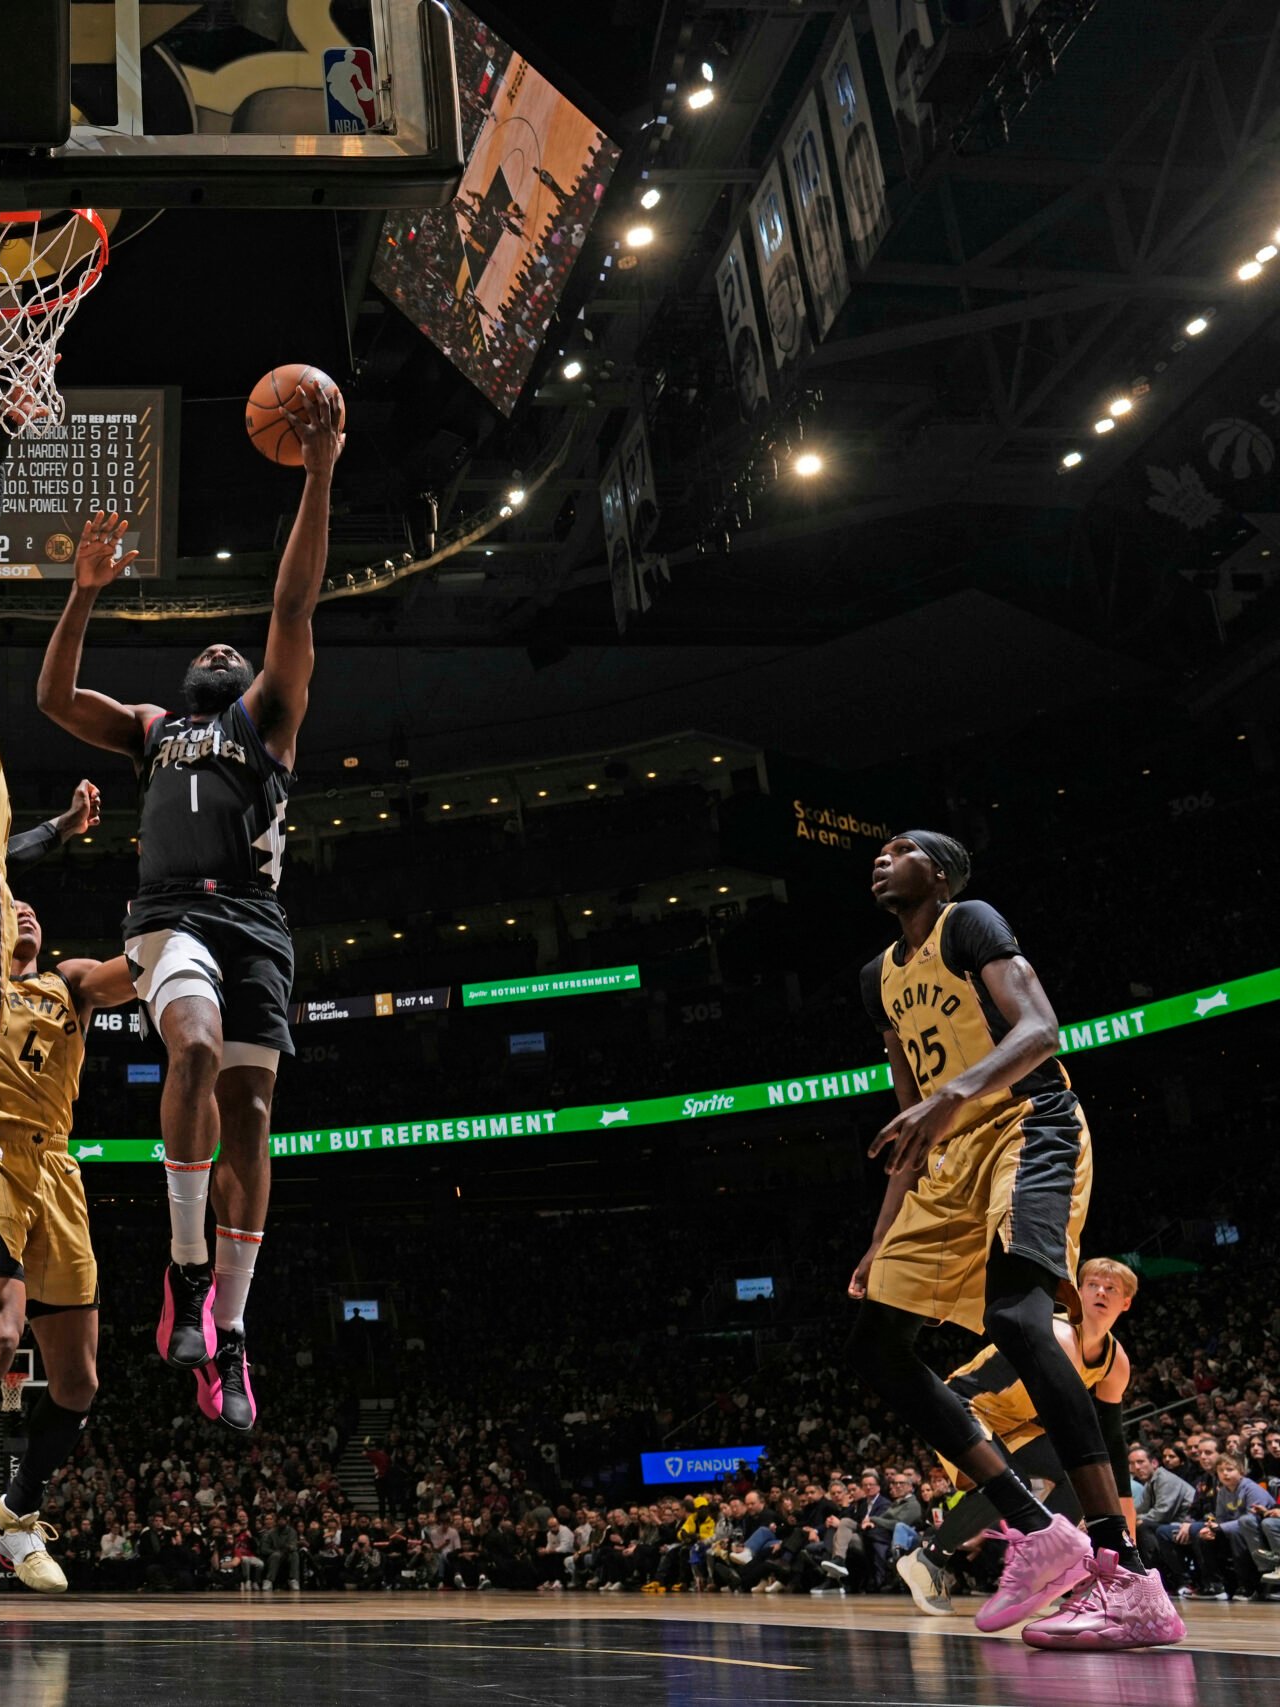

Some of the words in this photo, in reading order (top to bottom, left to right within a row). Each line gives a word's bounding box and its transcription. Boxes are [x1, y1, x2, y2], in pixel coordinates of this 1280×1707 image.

[334, 119, 359, 134] NBA
[723, 255, 747, 333] 21
[71, 415, 87, 424] PTS
[89, 415, 105, 424] REB
[106, 415, 122, 424] AST
[123, 415, 137, 424] FLS
[71, 425, 86, 439] 12
[91, 425, 101, 439] 5
[108, 425, 118, 439] 2
[125, 425, 133, 439] 1
[6, 443, 14, 458] 1
[18, 443, 25, 458] J.
[27, 443, 68, 458] HARDEN
[71, 443, 85, 458] 11
[90, 443, 100, 458] 3
[107, 443, 118, 458] 4
[125, 443, 133, 458] 1
[4, 462, 14, 477] 7
[17, 462, 27, 477] A.
[29, 462, 68, 477] COFFEY
[73, 462, 83, 477] 0
[91, 462, 99, 477] 1
[107, 462, 117, 477] 0
[124, 462, 134, 477] 2
[3, 480, 17, 495] 10
[18, 480, 30, 495] D.
[32, 480, 69, 495] THEIS
[73, 480, 83, 495] 0
[91, 480, 99, 495] 1
[108, 480, 116, 495] 1
[123, 480, 134, 495] 0
[2, 498, 17, 513] 24
[18, 498, 28, 513] N.
[29, 498, 69, 513] POWELL
[73, 498, 83, 513] 7
[90, 498, 100, 513] 2
[106, 498, 117, 513] 0
[124, 498, 133, 513] 1
[26, 536, 33, 550] 2
[124, 566, 131, 577] 6
[149, 731, 247, 784] Angeles
[190, 773, 199, 813] 1
[1168, 789, 1217, 817] 306
[796, 819, 852, 849] Arena
[491, 986, 529, 997] NOTHIN'
[532, 983, 550, 992] BUT
[552, 975, 621, 990] REFRESHMENT
[308, 1001, 336, 1012] Magic
[396, 997, 416, 1007] 8:07
[419, 995, 434, 1005] 1st
[889, 983, 961, 1035] ORONTO
[309, 1010, 349, 1022] Grizzlies
[680, 1000, 723, 1024] 305
[94, 1013, 123, 1031] 46
[18, 1029, 44, 1073] 4
[302, 1045, 339, 1064] 304
[907, 1025, 947, 1084] 25
[681, 1094, 735, 1118] Sprite
[767, 1069, 877, 1105] NOTHIN'
[330, 1129, 373, 1150] BUT
[381, 1112, 557, 1146] REFRESHMENT
[686, 1457, 744, 1473] FANDUE
